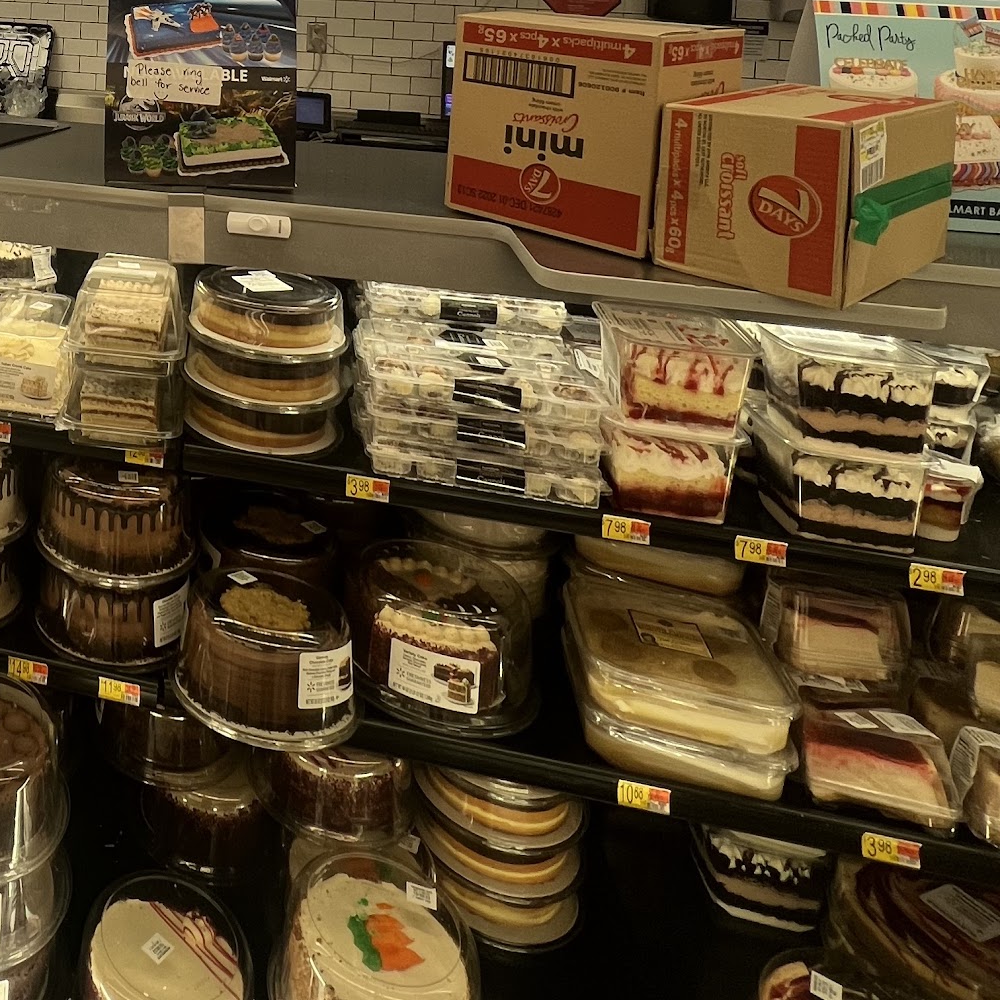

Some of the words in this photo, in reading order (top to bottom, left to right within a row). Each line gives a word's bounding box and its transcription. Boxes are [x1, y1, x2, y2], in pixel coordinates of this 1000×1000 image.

[877, 24, 917, 51] Party
[130, 74, 148, 88] bell
[155, 79, 172, 90] for
[178, 82, 210, 96] service
[134, 62, 172, 77] Please
[183, 69, 203, 86] ring
[513, 112, 580, 133] Croissants
[502, 124, 585, 162] mini
[524, 168, 543, 193] DAYS
[734, 154, 748, 181] soft
[530, 169, 551, 199] 7
[759, 186, 809, 225] 7
[759, 199, 805, 233] DAYS
